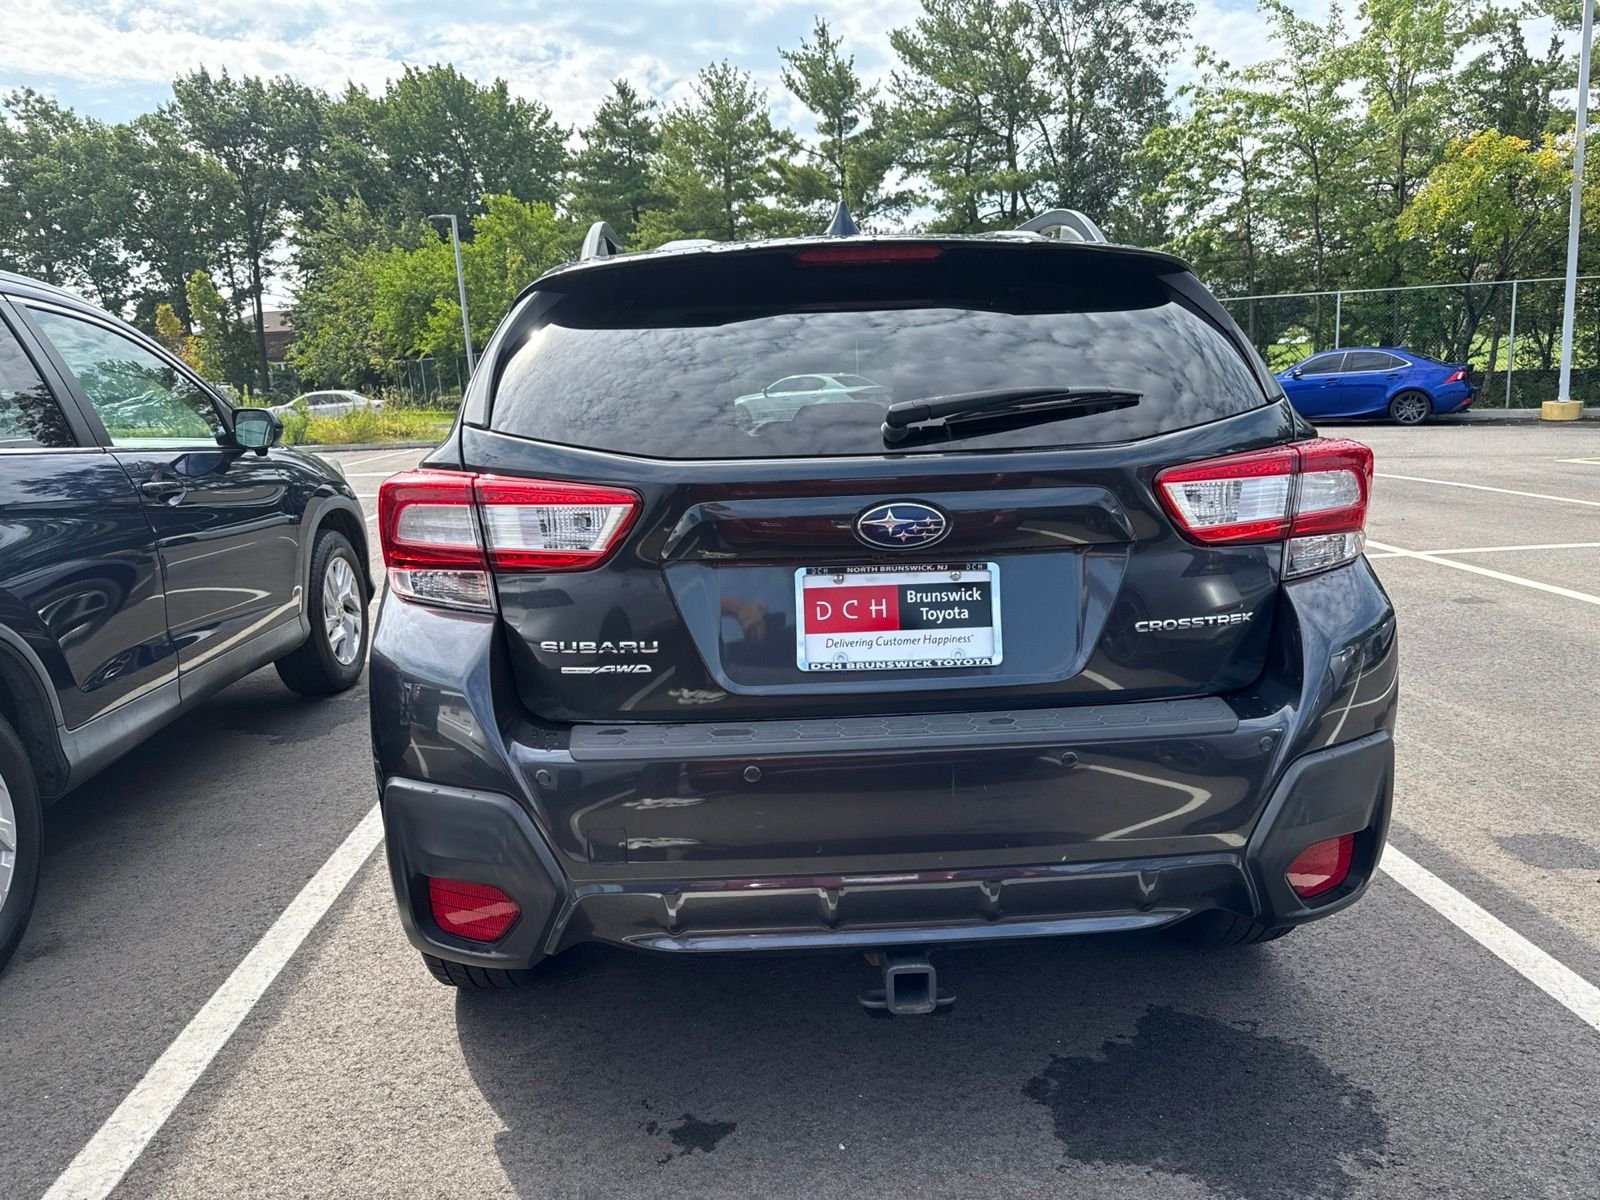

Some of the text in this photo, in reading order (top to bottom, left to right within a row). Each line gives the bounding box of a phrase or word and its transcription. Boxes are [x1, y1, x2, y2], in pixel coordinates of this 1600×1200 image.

[906, 587, 982, 603] Brunswick
[920, 606, 969, 624] Toyota
[1134, 612, 1254, 633] CROSSTREK
[540, 640, 659, 654] SUBARU
[825, 634, 971, 649] Delivering Customer Happiness
[594, 664, 653, 675] AWD
[810, 657, 992, 670] DCH BRUNSWICK TOYOTA
